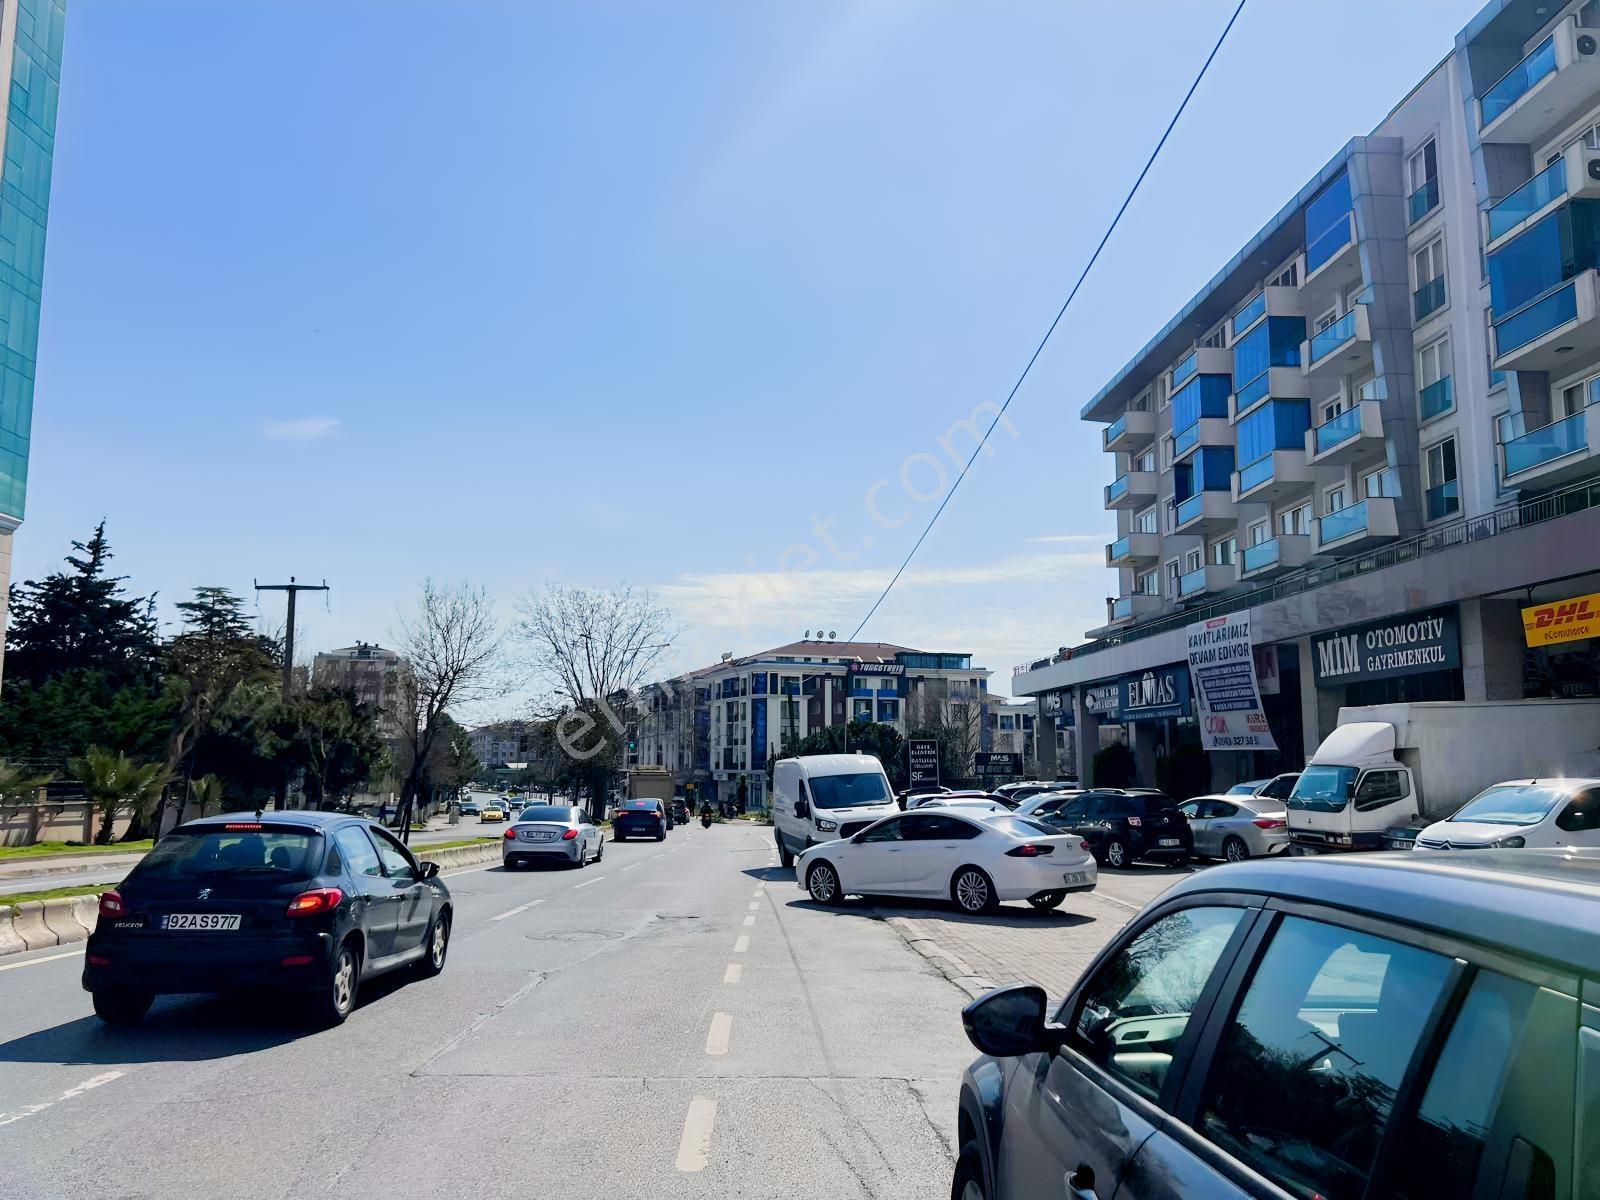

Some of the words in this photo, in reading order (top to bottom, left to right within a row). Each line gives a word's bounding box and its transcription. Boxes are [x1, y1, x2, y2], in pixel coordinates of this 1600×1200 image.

[1534, 600, 1596, 629] DHL
[1188, 623, 1249, 649] KAYITLARIMIZ
[1366, 616, 1444, 650] OTOMOTİV
[1189, 648, 1217, 666] DEVAM
[1218, 641, 1250, 661] EDİYOR
[1317, 632, 1361, 678] MİM
[1367, 645, 1446, 672] GAYRİMENKUL
[1128, 674, 1176, 708] ELMAS
